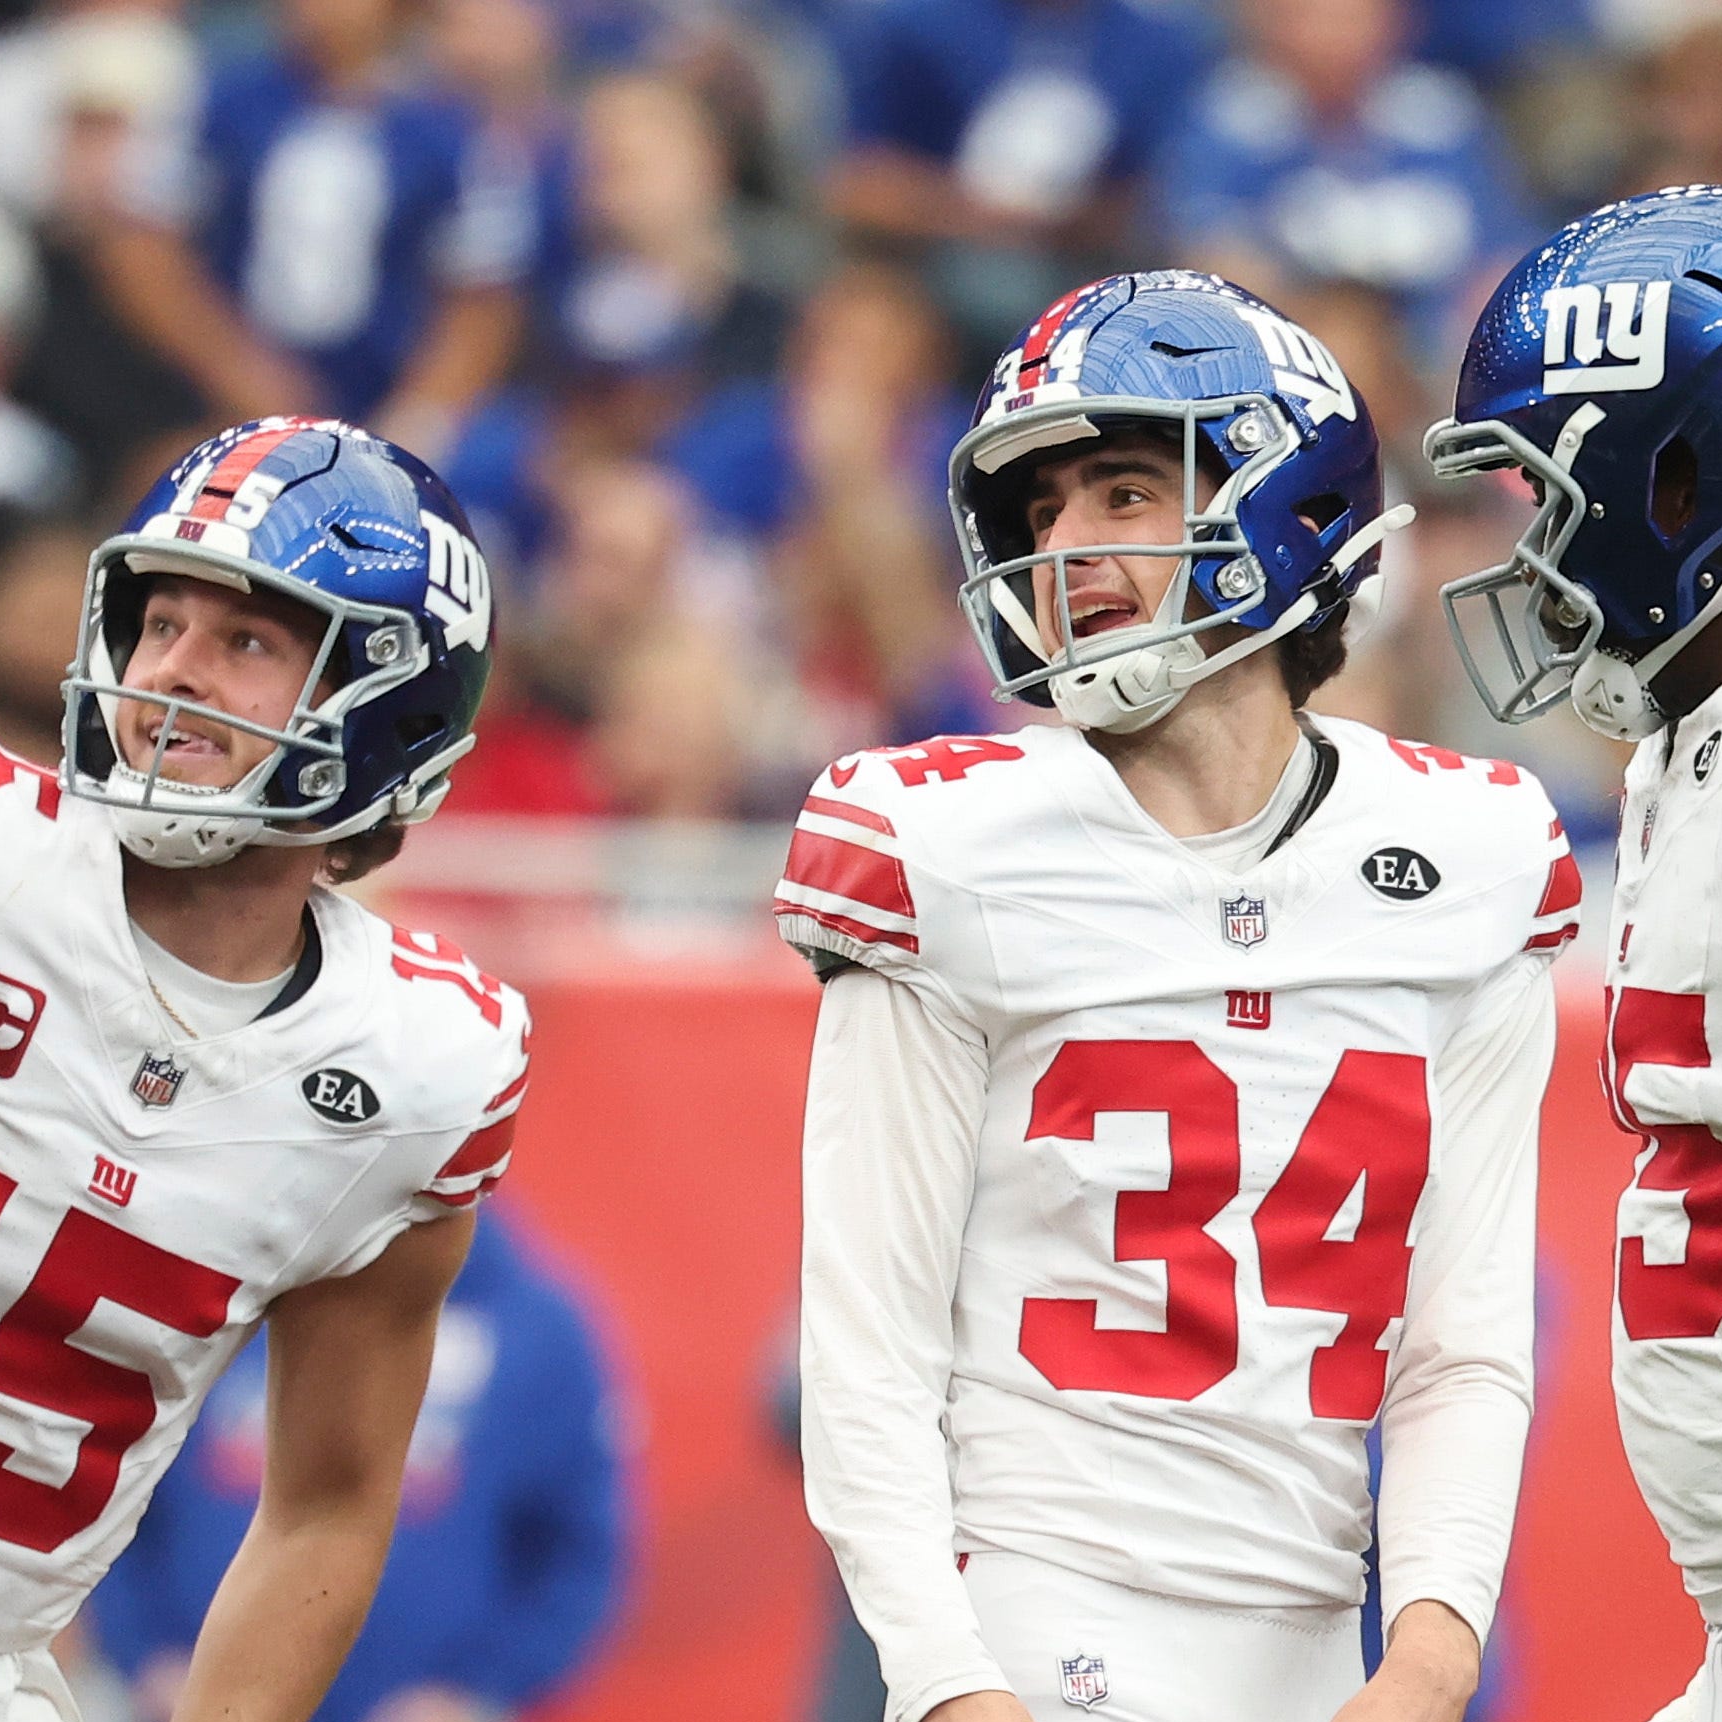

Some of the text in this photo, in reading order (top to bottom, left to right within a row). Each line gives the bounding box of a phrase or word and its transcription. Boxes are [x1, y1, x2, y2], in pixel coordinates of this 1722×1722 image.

[1372, 854, 1430, 892] EA
[1230, 917, 1263, 942] NFL
[1224, 989, 1272, 1030] ny
[137, 1073, 173, 1102] NFL
[310, 1071, 366, 1119] EA
[87, 1153, 138, 1208] ny
[1018, 1039, 1433, 1421] 34
[1069, 1675, 1105, 1698] NFL
